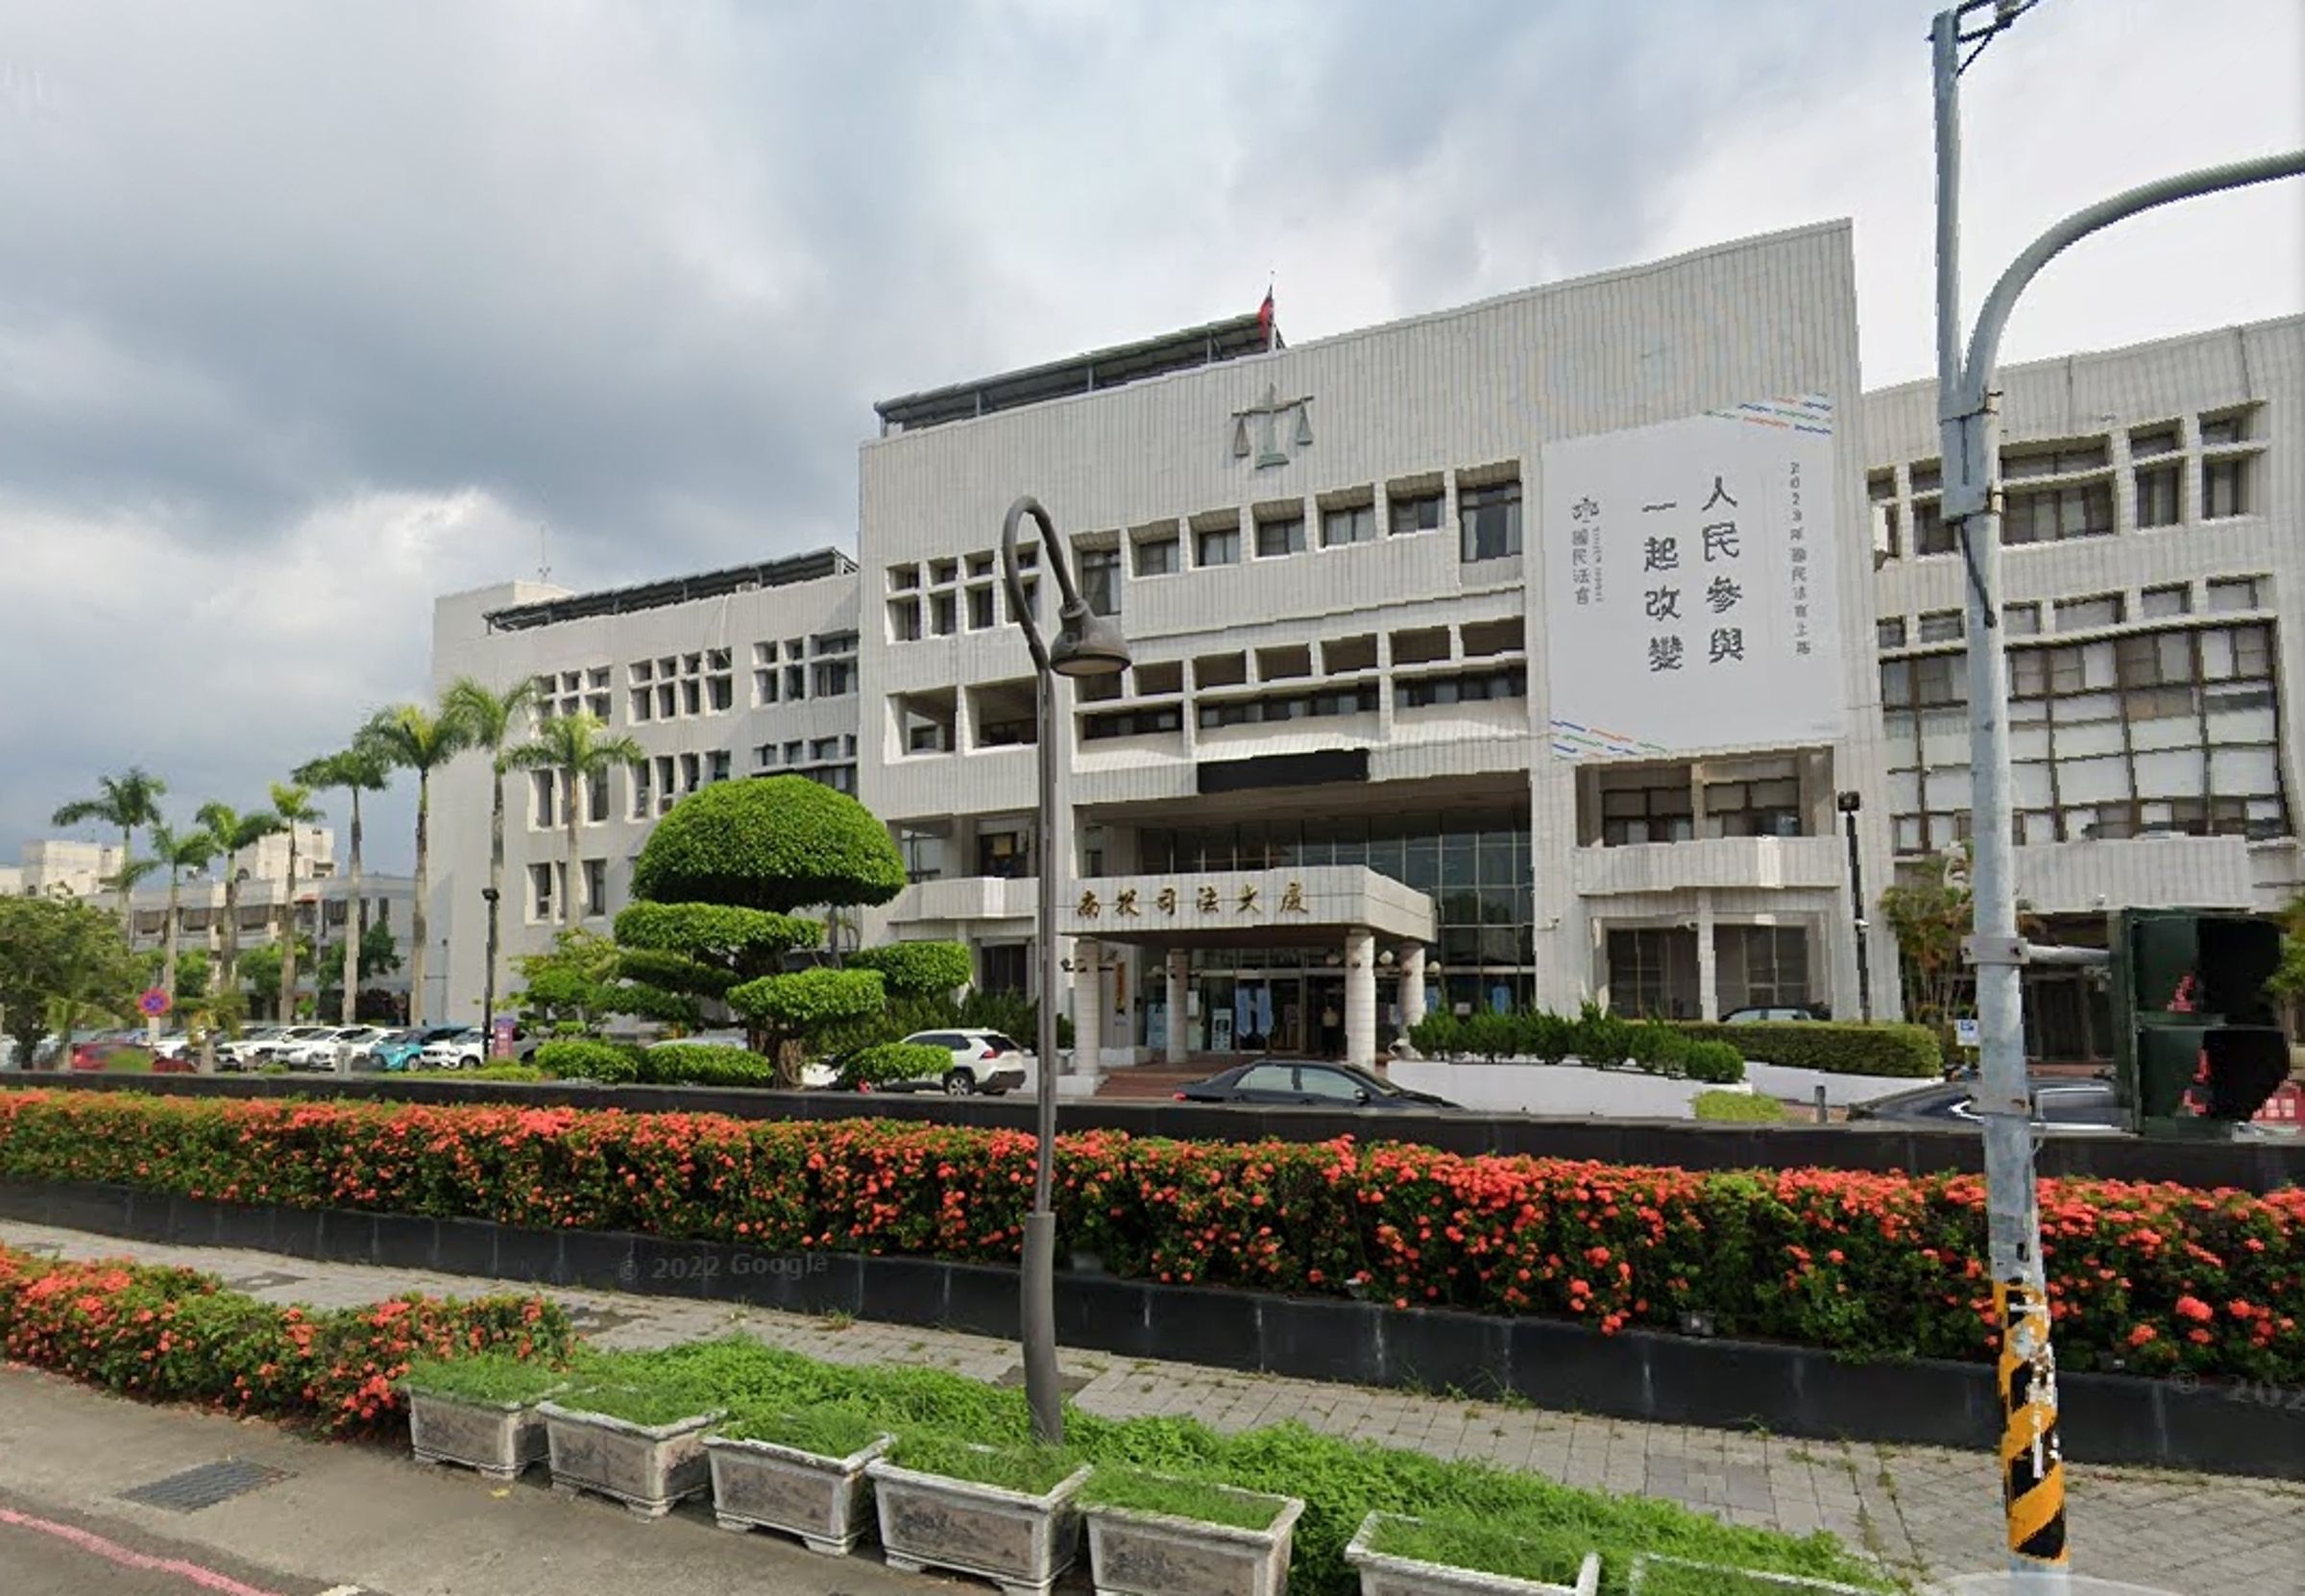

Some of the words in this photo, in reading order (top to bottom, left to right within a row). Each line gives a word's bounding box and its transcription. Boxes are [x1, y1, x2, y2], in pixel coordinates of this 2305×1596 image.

[1641, 502, 1685, 672] 一起改變
[1701, 476, 1744, 664] 人民參與
